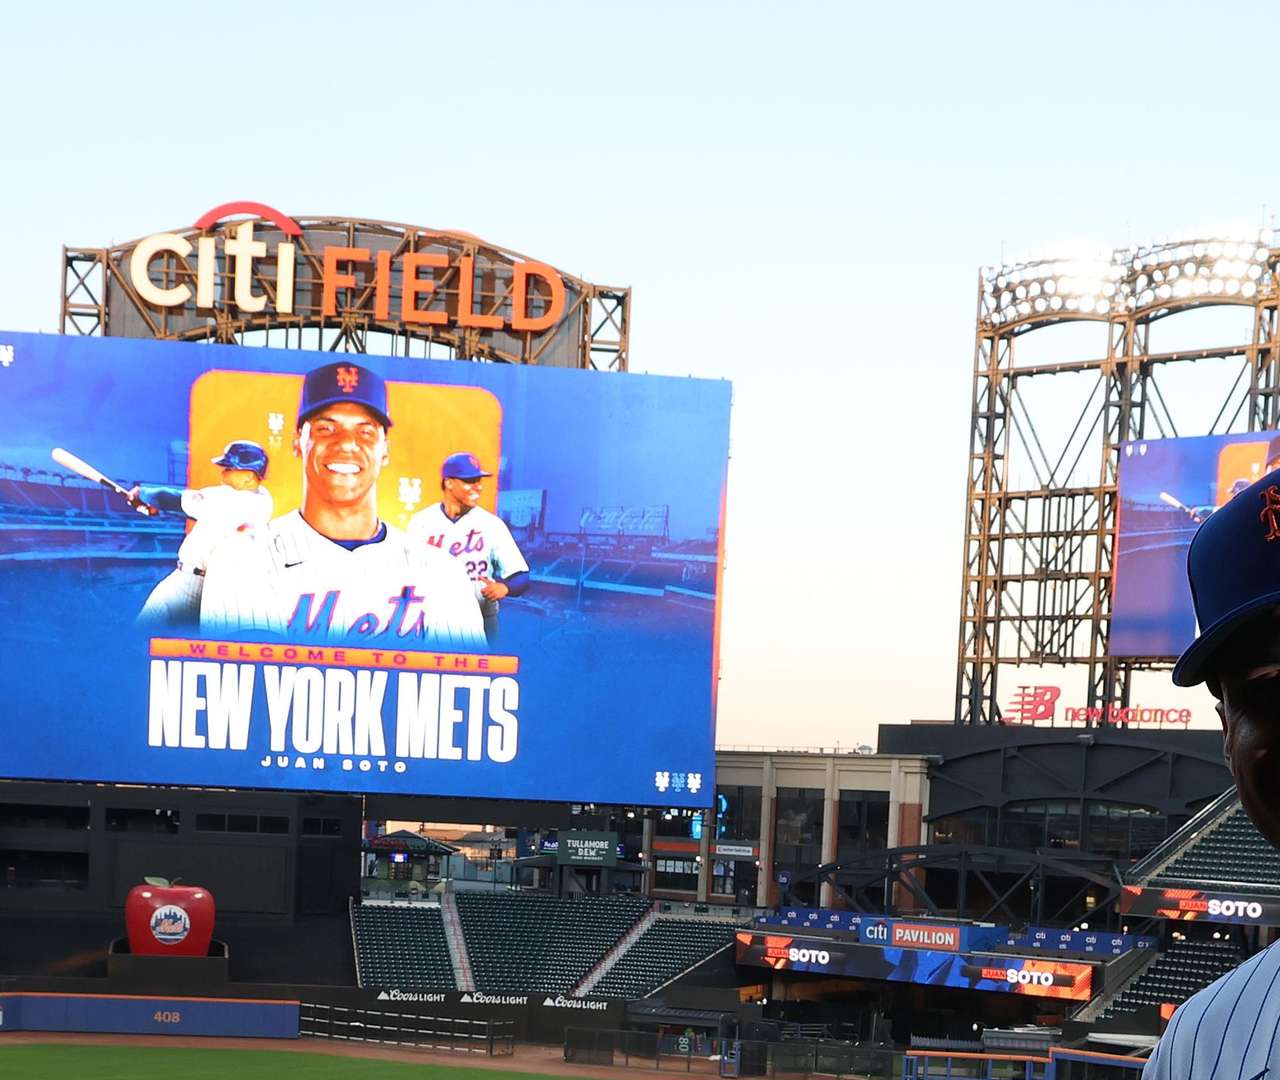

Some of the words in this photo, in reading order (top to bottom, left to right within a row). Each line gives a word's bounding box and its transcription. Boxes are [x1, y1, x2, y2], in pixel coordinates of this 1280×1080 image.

[130, 220, 296, 314] citi
[322, 246, 566, 333] FIELD
[189, 642, 347, 663] WELCOME
[372, 652, 408, 666] TO
[433, 655, 490, 670] THE
[147, 659, 256, 750] NEW
[263, 664, 389, 758] YORK
[394, 671, 520, 764] METS
[1064, 706, 1105, 722] new
[1107, 702, 1192, 724] balance
[260, 754, 325, 771] JUAN
[342, 758, 408, 774] SOTO
[566, 839, 610, 850] TULLAMORE
[1207, 899, 1263, 919] SOTO
[865, 925, 888, 941] citi
[895, 928, 955, 946] PAVILION
[788, 947, 830, 964] SOTO
[1006, 968, 1054, 986] SOTO
[389, 988, 419, 1001] Coors
[419, 993, 446, 1002] LIGHT
[472, 991, 502, 1004] Coors
[502, 995, 529, 1005] LIGHT
[554, 995, 582, 1009] Coors
[582, 1000, 609, 1011] LIGHT
[153, 1011, 181, 1024] 408
